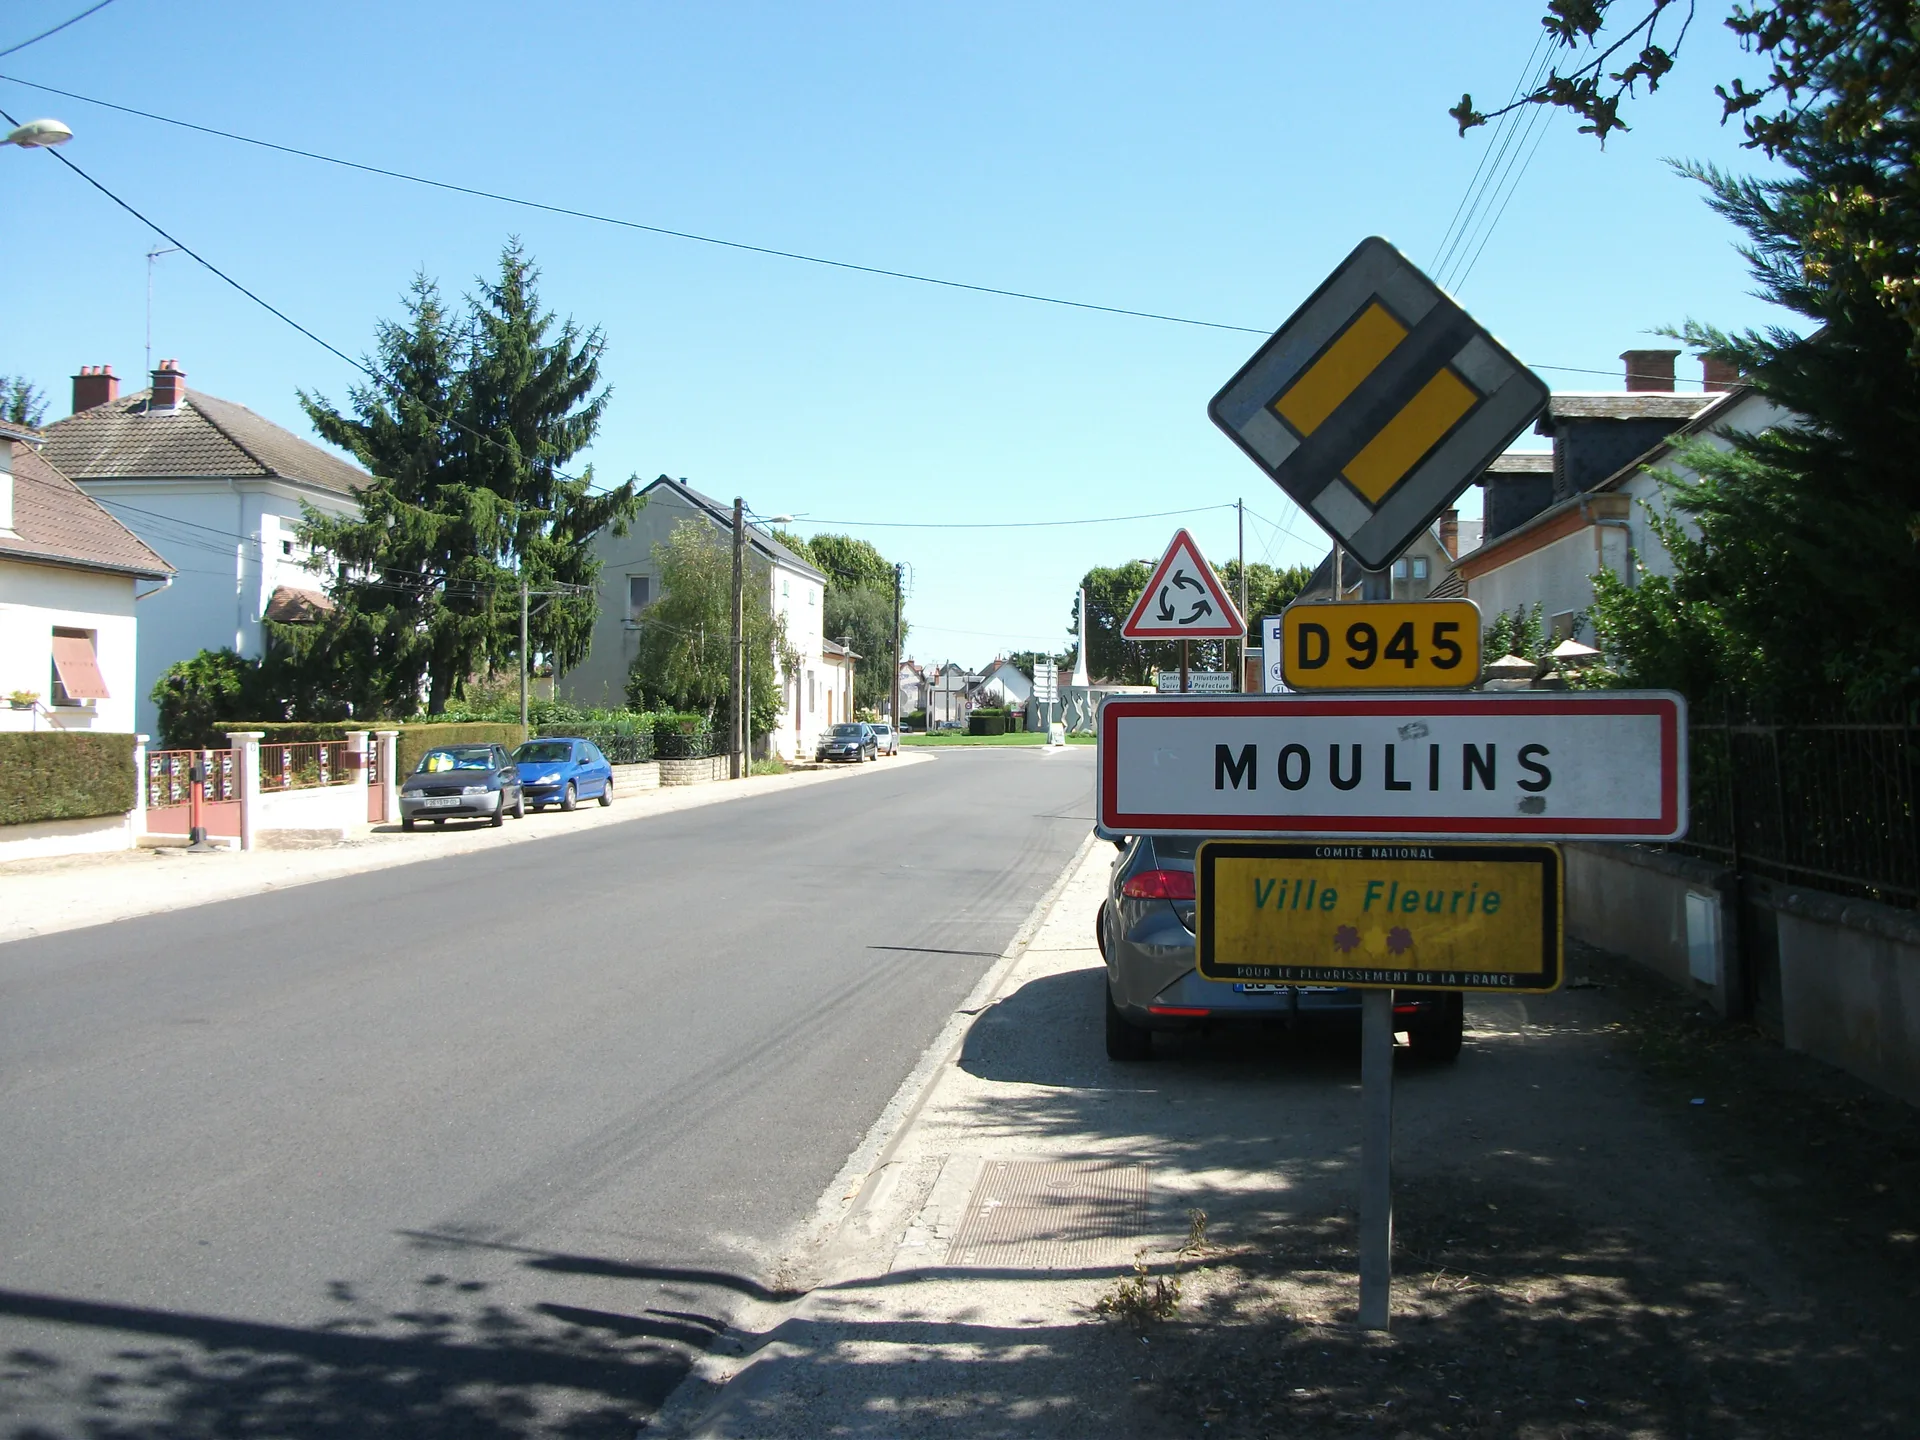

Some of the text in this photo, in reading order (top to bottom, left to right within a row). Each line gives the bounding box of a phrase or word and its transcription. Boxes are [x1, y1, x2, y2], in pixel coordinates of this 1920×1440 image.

[1298, 621, 1463, 671] D 945
[1214, 743, 1552, 792] MOULINS
[1371, 847, 1435, 859] NATIONAL
[1253, 878, 1502, 915] Ville Fleurie
[1237, 966, 1516, 986] POUR LE FLEURISSEMENT DE LA FRANCE
